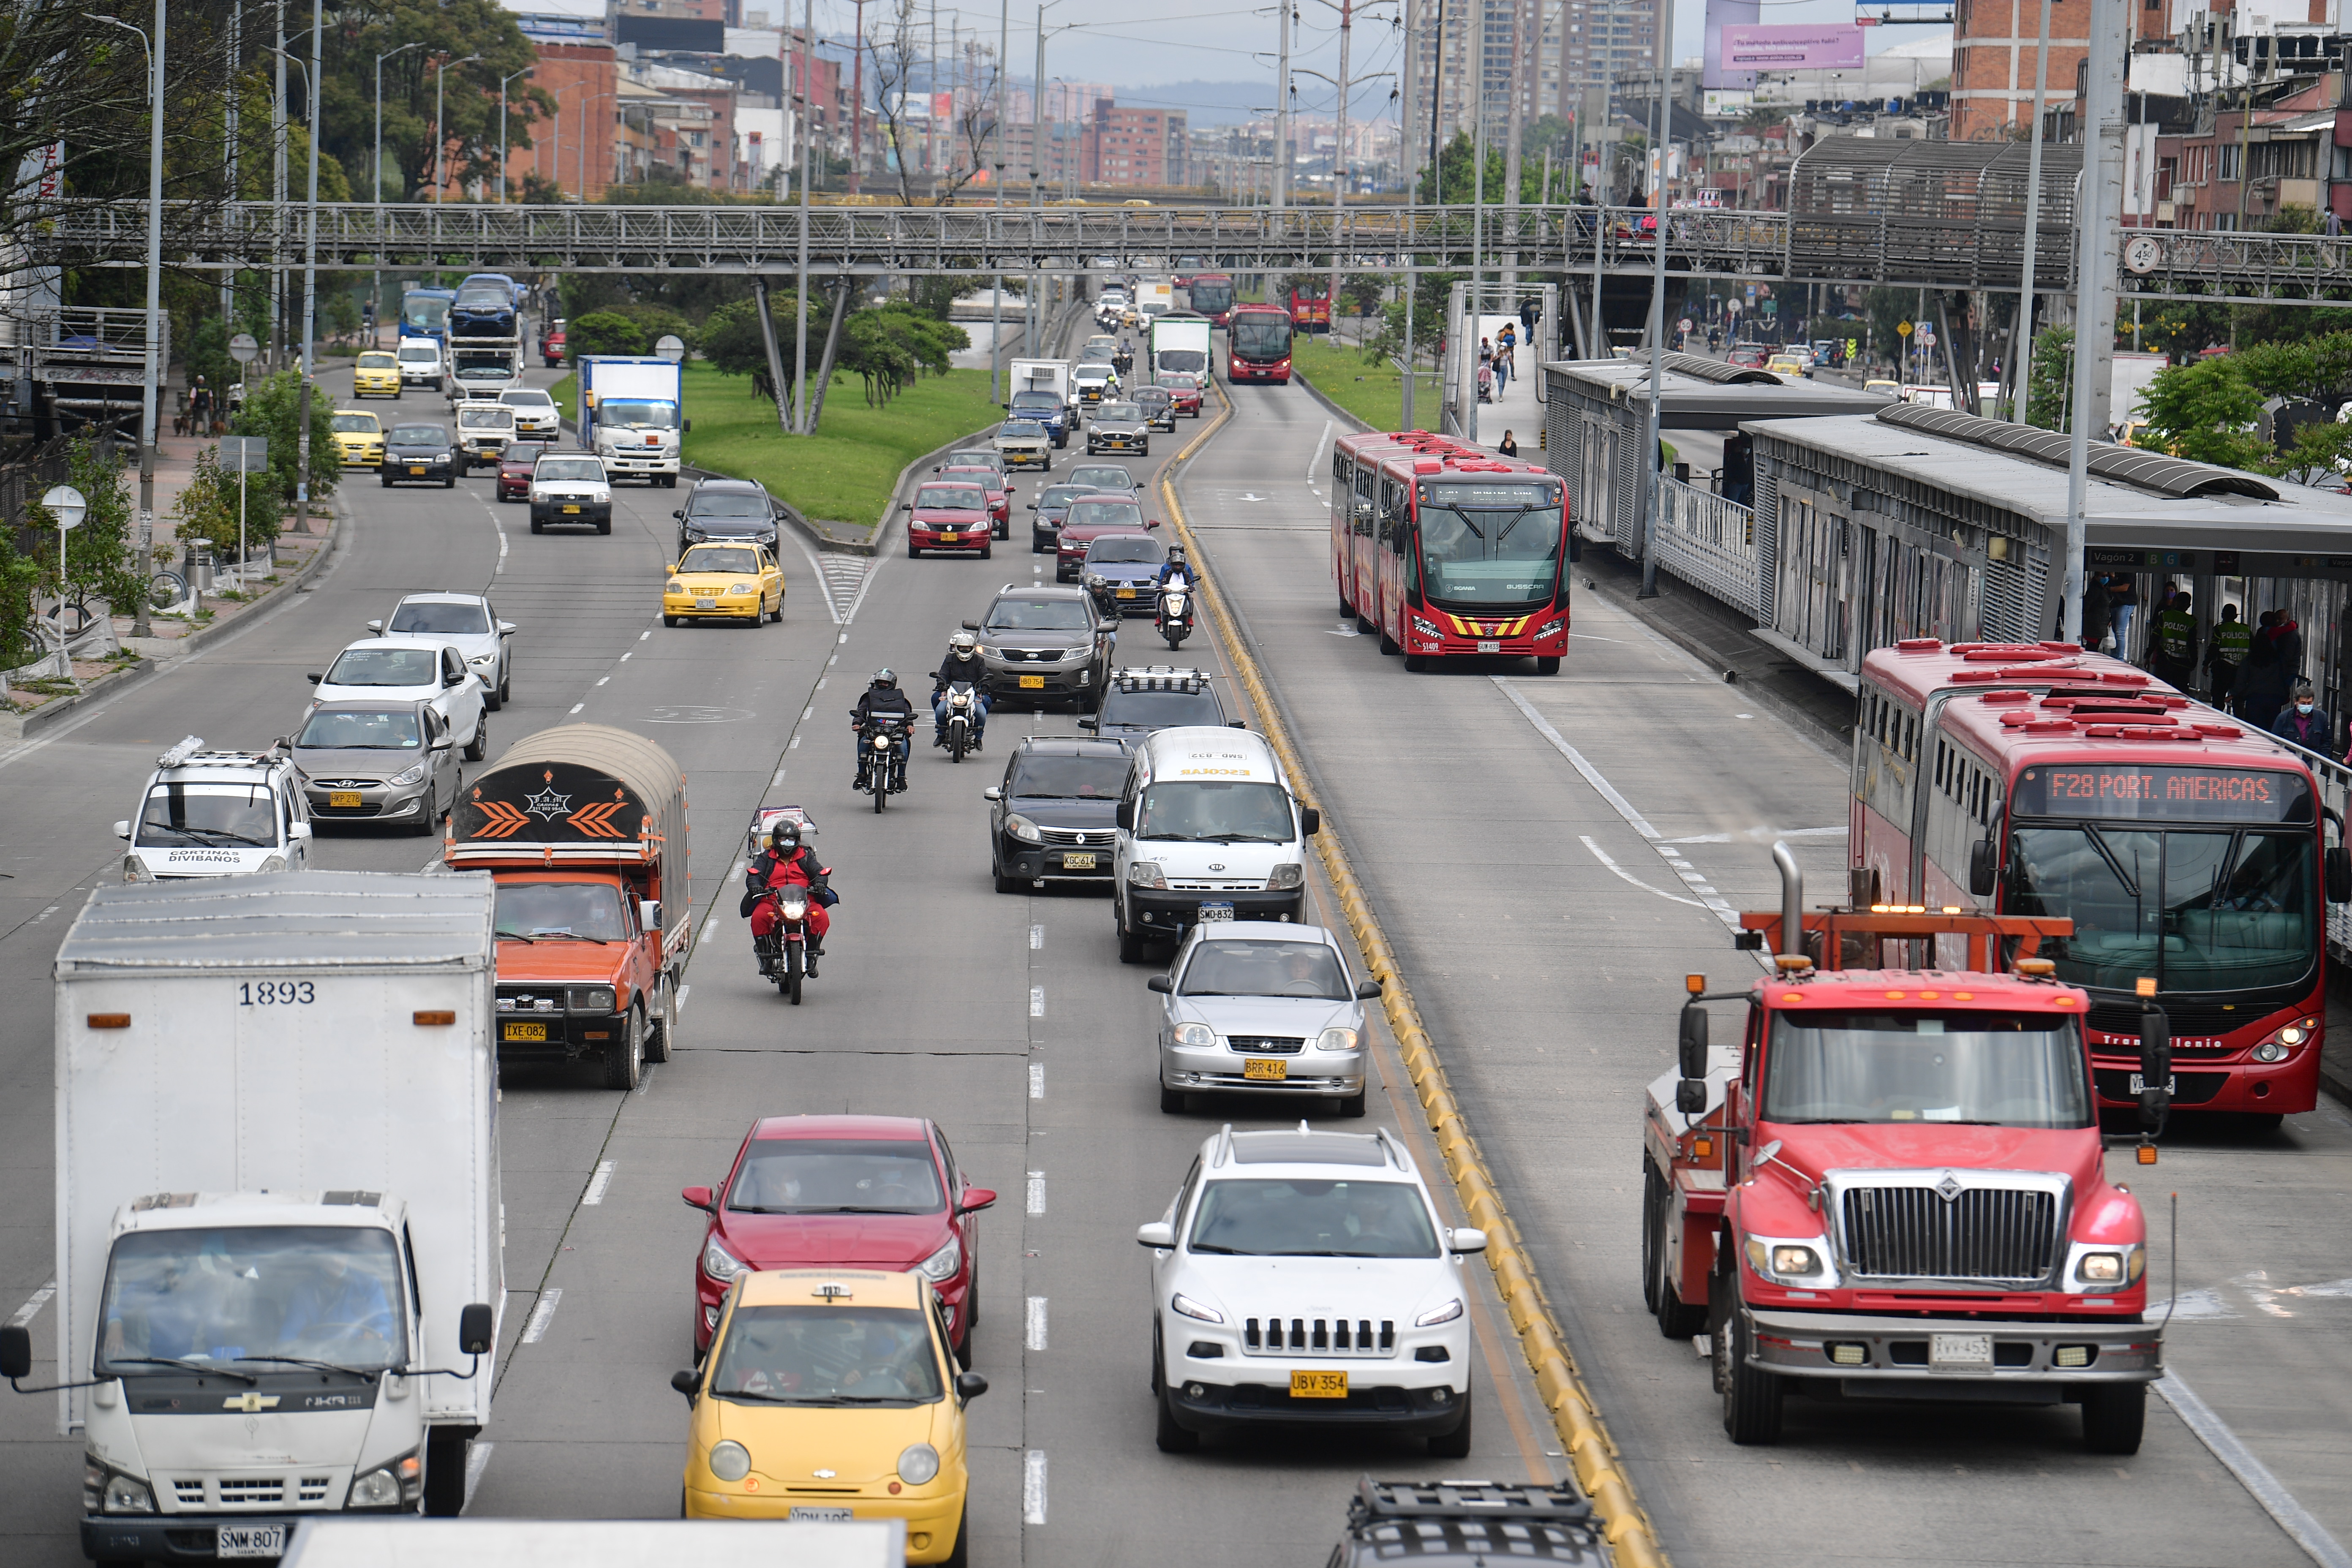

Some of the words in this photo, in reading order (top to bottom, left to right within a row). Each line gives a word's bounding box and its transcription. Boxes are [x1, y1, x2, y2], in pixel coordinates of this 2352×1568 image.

[2094, 553, 2126, 564] Vagón
[2129, 554, 2134, 562] 2
[2150, 555, 2157, 564] B
[2167, 555, 2175, 564] G
[1423, 642, 1438, 651] S1409
[2053, 773, 2094, 798] F28
[2099, 775, 2157, 799] PORT.
[2167, 776, 2270, 801] AMERICAS
[169, 854, 241, 863] DIVIBAÑOS
[240, 982, 315, 1006] 1893
[305, 1396, 346, 1407] NKR
